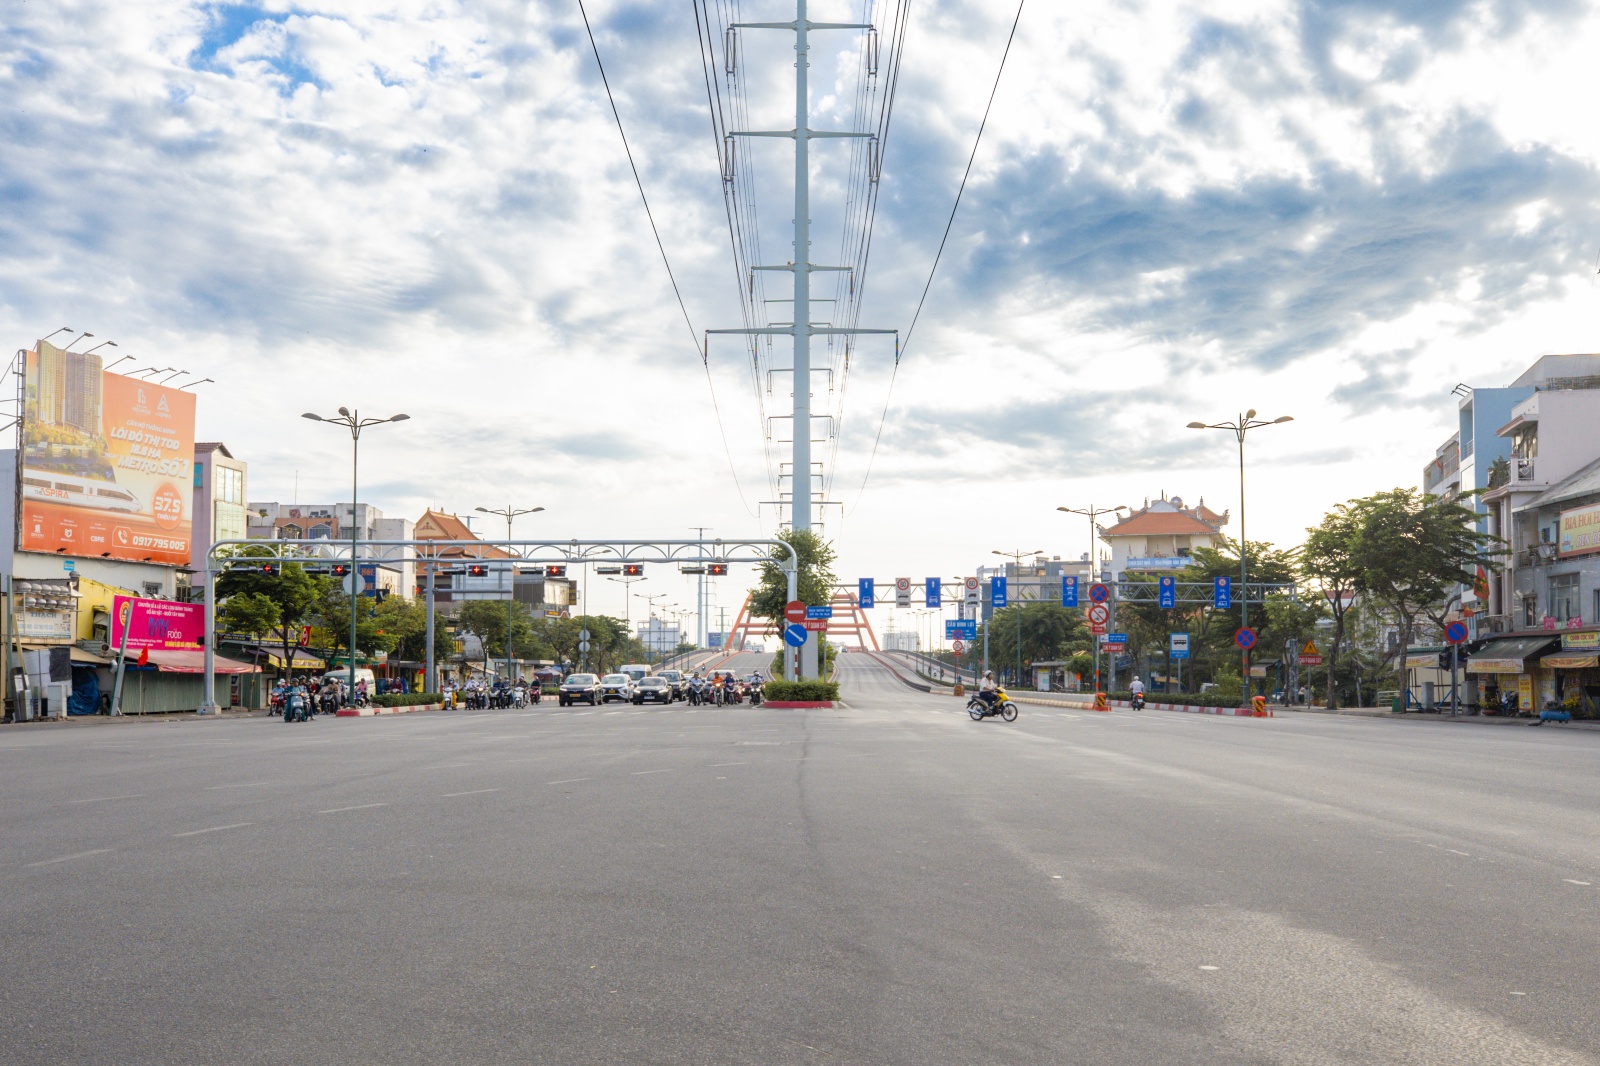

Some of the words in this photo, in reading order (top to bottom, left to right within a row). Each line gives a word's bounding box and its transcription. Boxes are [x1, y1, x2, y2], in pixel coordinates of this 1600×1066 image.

[161, 438, 180, 450] TOD
[130, 444, 148, 456] 18.8
[148, 448, 161, 459] HA
[158, 458, 181, 476] SỐ
[41, 488, 69, 499] ASPIRA
[155, 496, 180, 513] 37.5
[1565, 516, 1577, 530] BIA
[1594, 510, 1600, 524] H
[132, 536, 152, 546] 0917
[152, 539, 168, 548] 795
[170, 541, 185, 550] 005
[168, 630, 182, 638] FOOD
